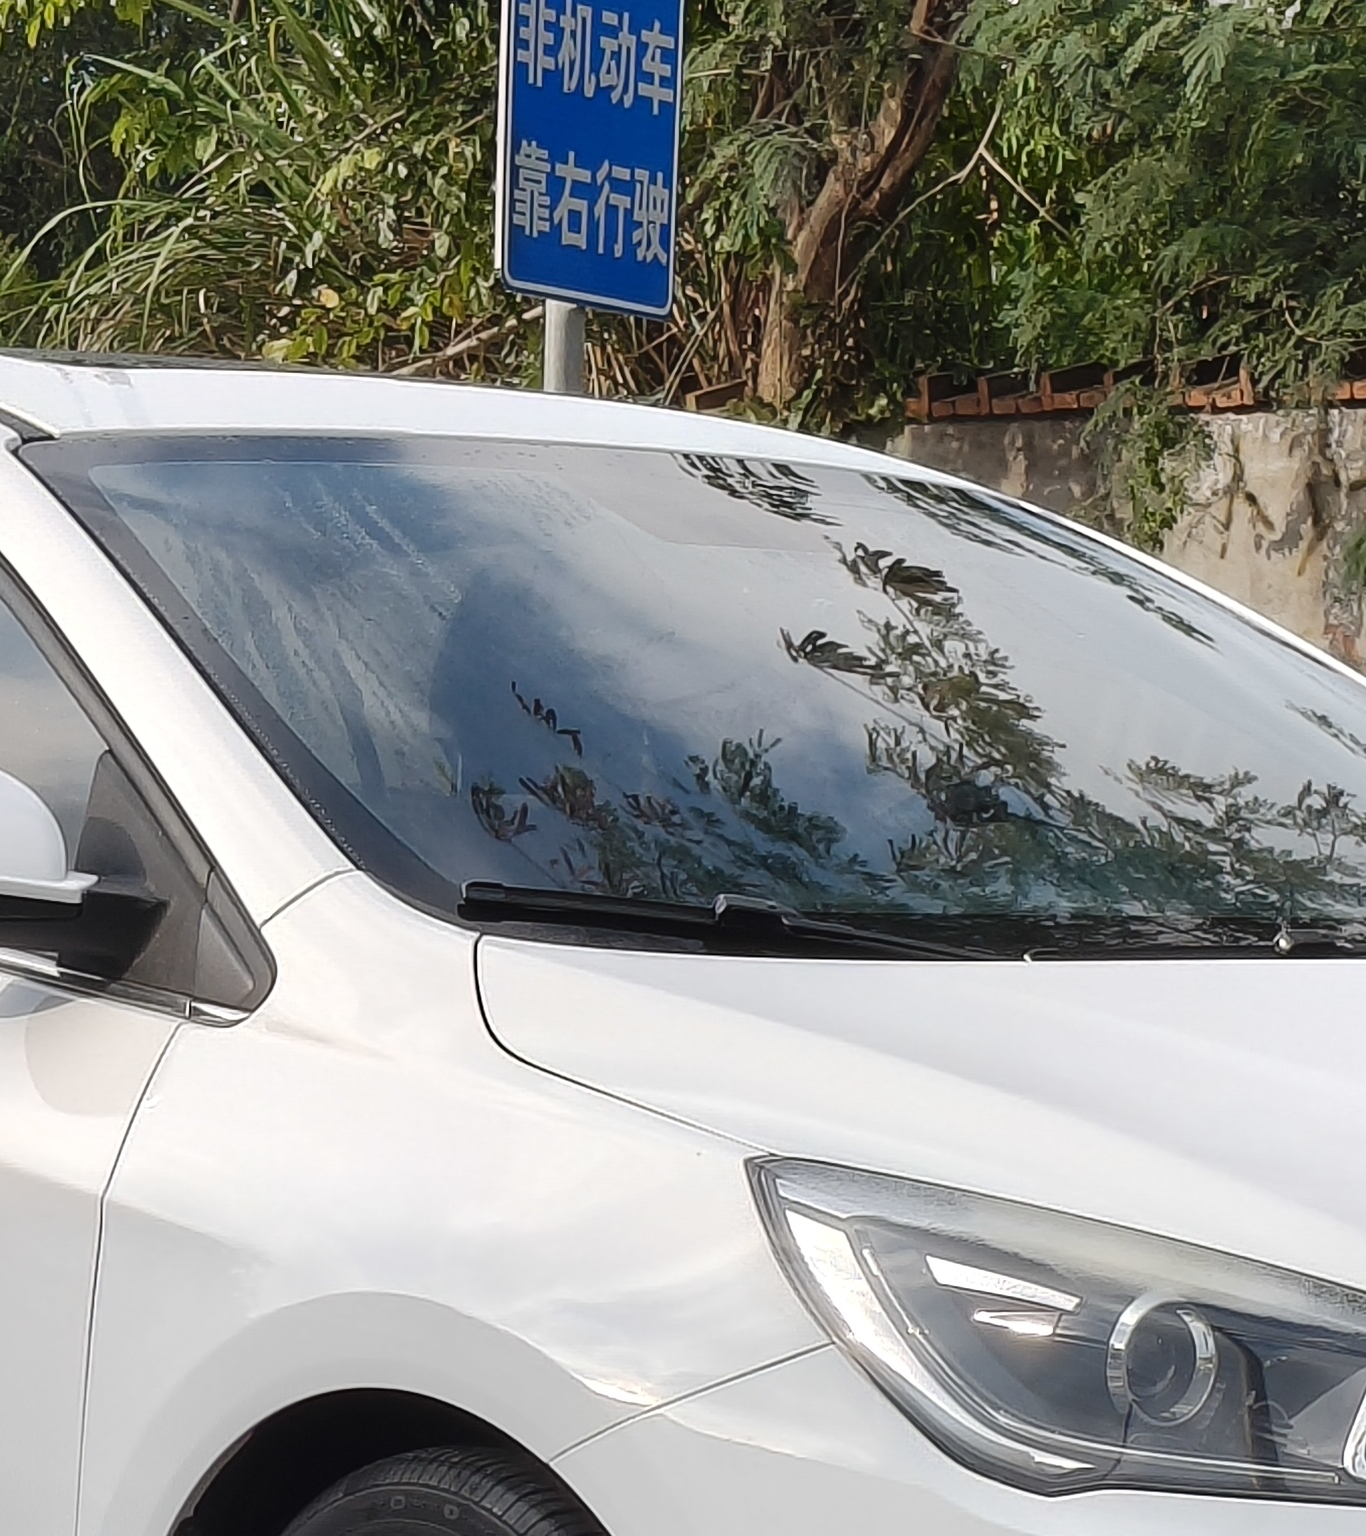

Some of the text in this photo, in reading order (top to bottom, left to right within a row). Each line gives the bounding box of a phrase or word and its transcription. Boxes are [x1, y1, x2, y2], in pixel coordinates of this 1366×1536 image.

[517, 0, 675, 115] 非机动车
[513, 139, 669, 266] 靠右行驶
